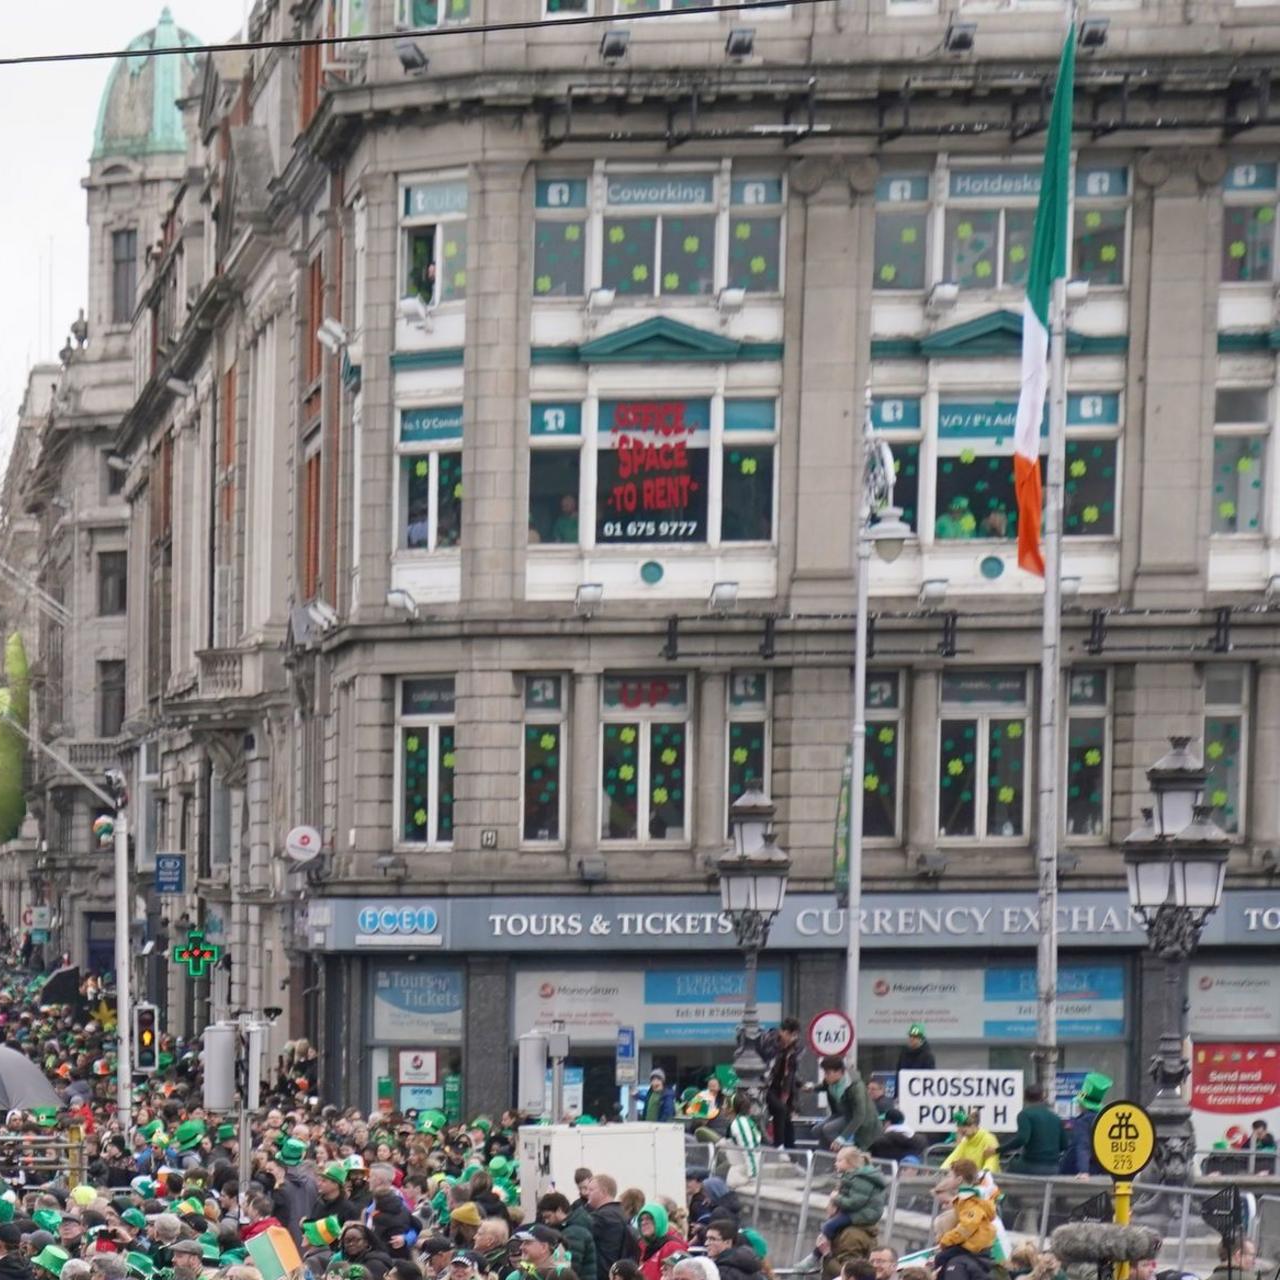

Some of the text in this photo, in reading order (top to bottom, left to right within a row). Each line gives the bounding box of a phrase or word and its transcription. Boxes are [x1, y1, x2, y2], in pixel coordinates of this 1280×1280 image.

[607, 181, 706, 203] Coworking
[956, 175, 1041, 197] Hotdesks
[615, 402, 686, 434] OFFICE
[617, 435, 688, 477] SPACE
[614, 476, 692, 512] TO RENT
[603, 521, 697, 537] 01 675 9777
[619, 680, 671, 709] UP
[360, 907, 436, 933] FCEI
[489, 911, 733, 936] TOURS & TICKETS
[795, 905, 1148, 936] CURRENCY EXCHAN
[394, 971, 433, 988] Tours
[892, 982, 957, 994] MoneyGram
[1214, 978, 1271, 988] MoneyGram
[406, 989, 459, 1006] Tickets
[556, 985, 620, 997] MoneyGram
[1208, 1069, 1262, 1082] Send and
[908, 1077, 1015, 1098] CROSSING
[1195, 1083, 1277, 1096] receive money
[1207, 1095, 1264, 1106] from here
[918, 1105, 1007, 1124] POINT H
[1110, 1140, 1136, 1153] BUS
[1112, 1158, 1134, 1170] 273
